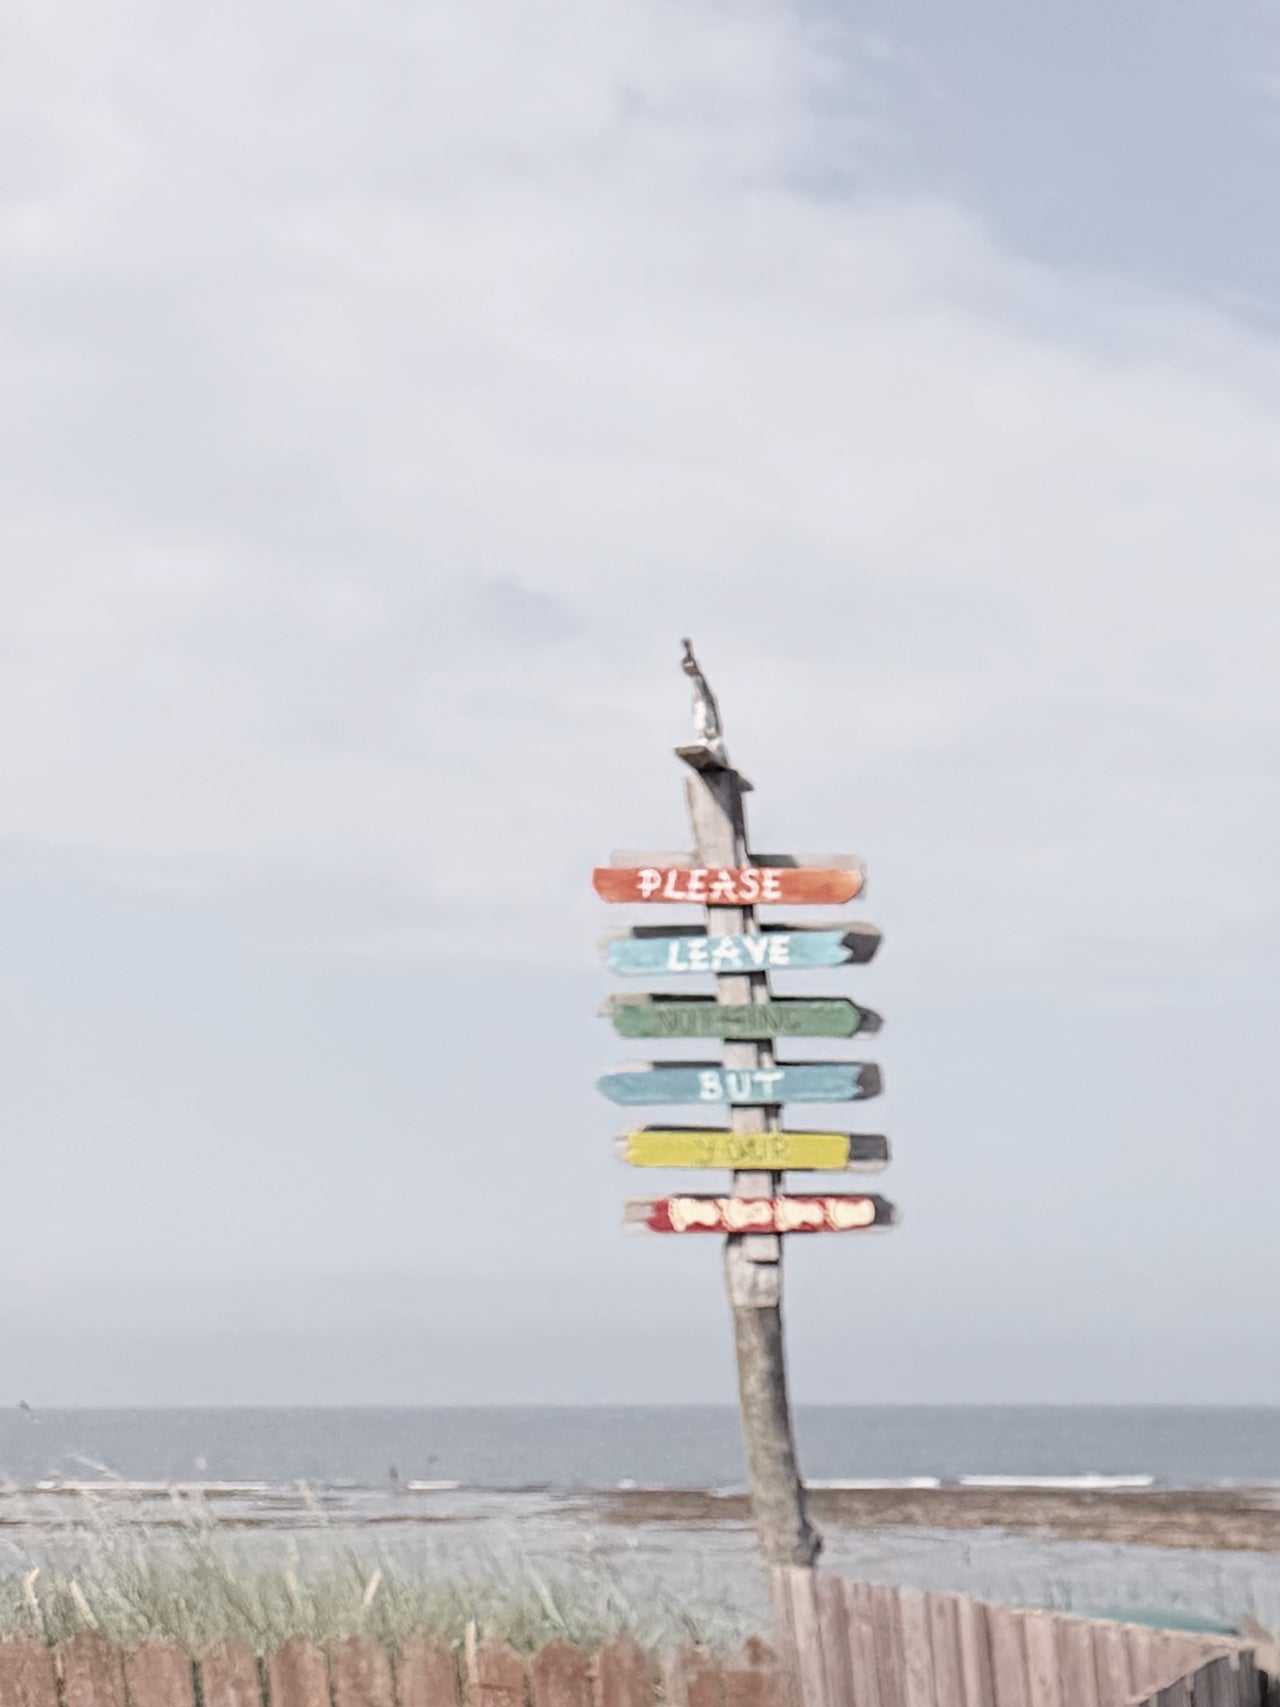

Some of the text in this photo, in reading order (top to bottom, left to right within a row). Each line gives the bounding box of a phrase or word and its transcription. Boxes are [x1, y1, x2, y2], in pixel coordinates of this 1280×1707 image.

[637, 868, 783, 901] PLEASE
[666, 934, 791, 972] LEAVE
[698, 1070, 785, 1101] BUT
